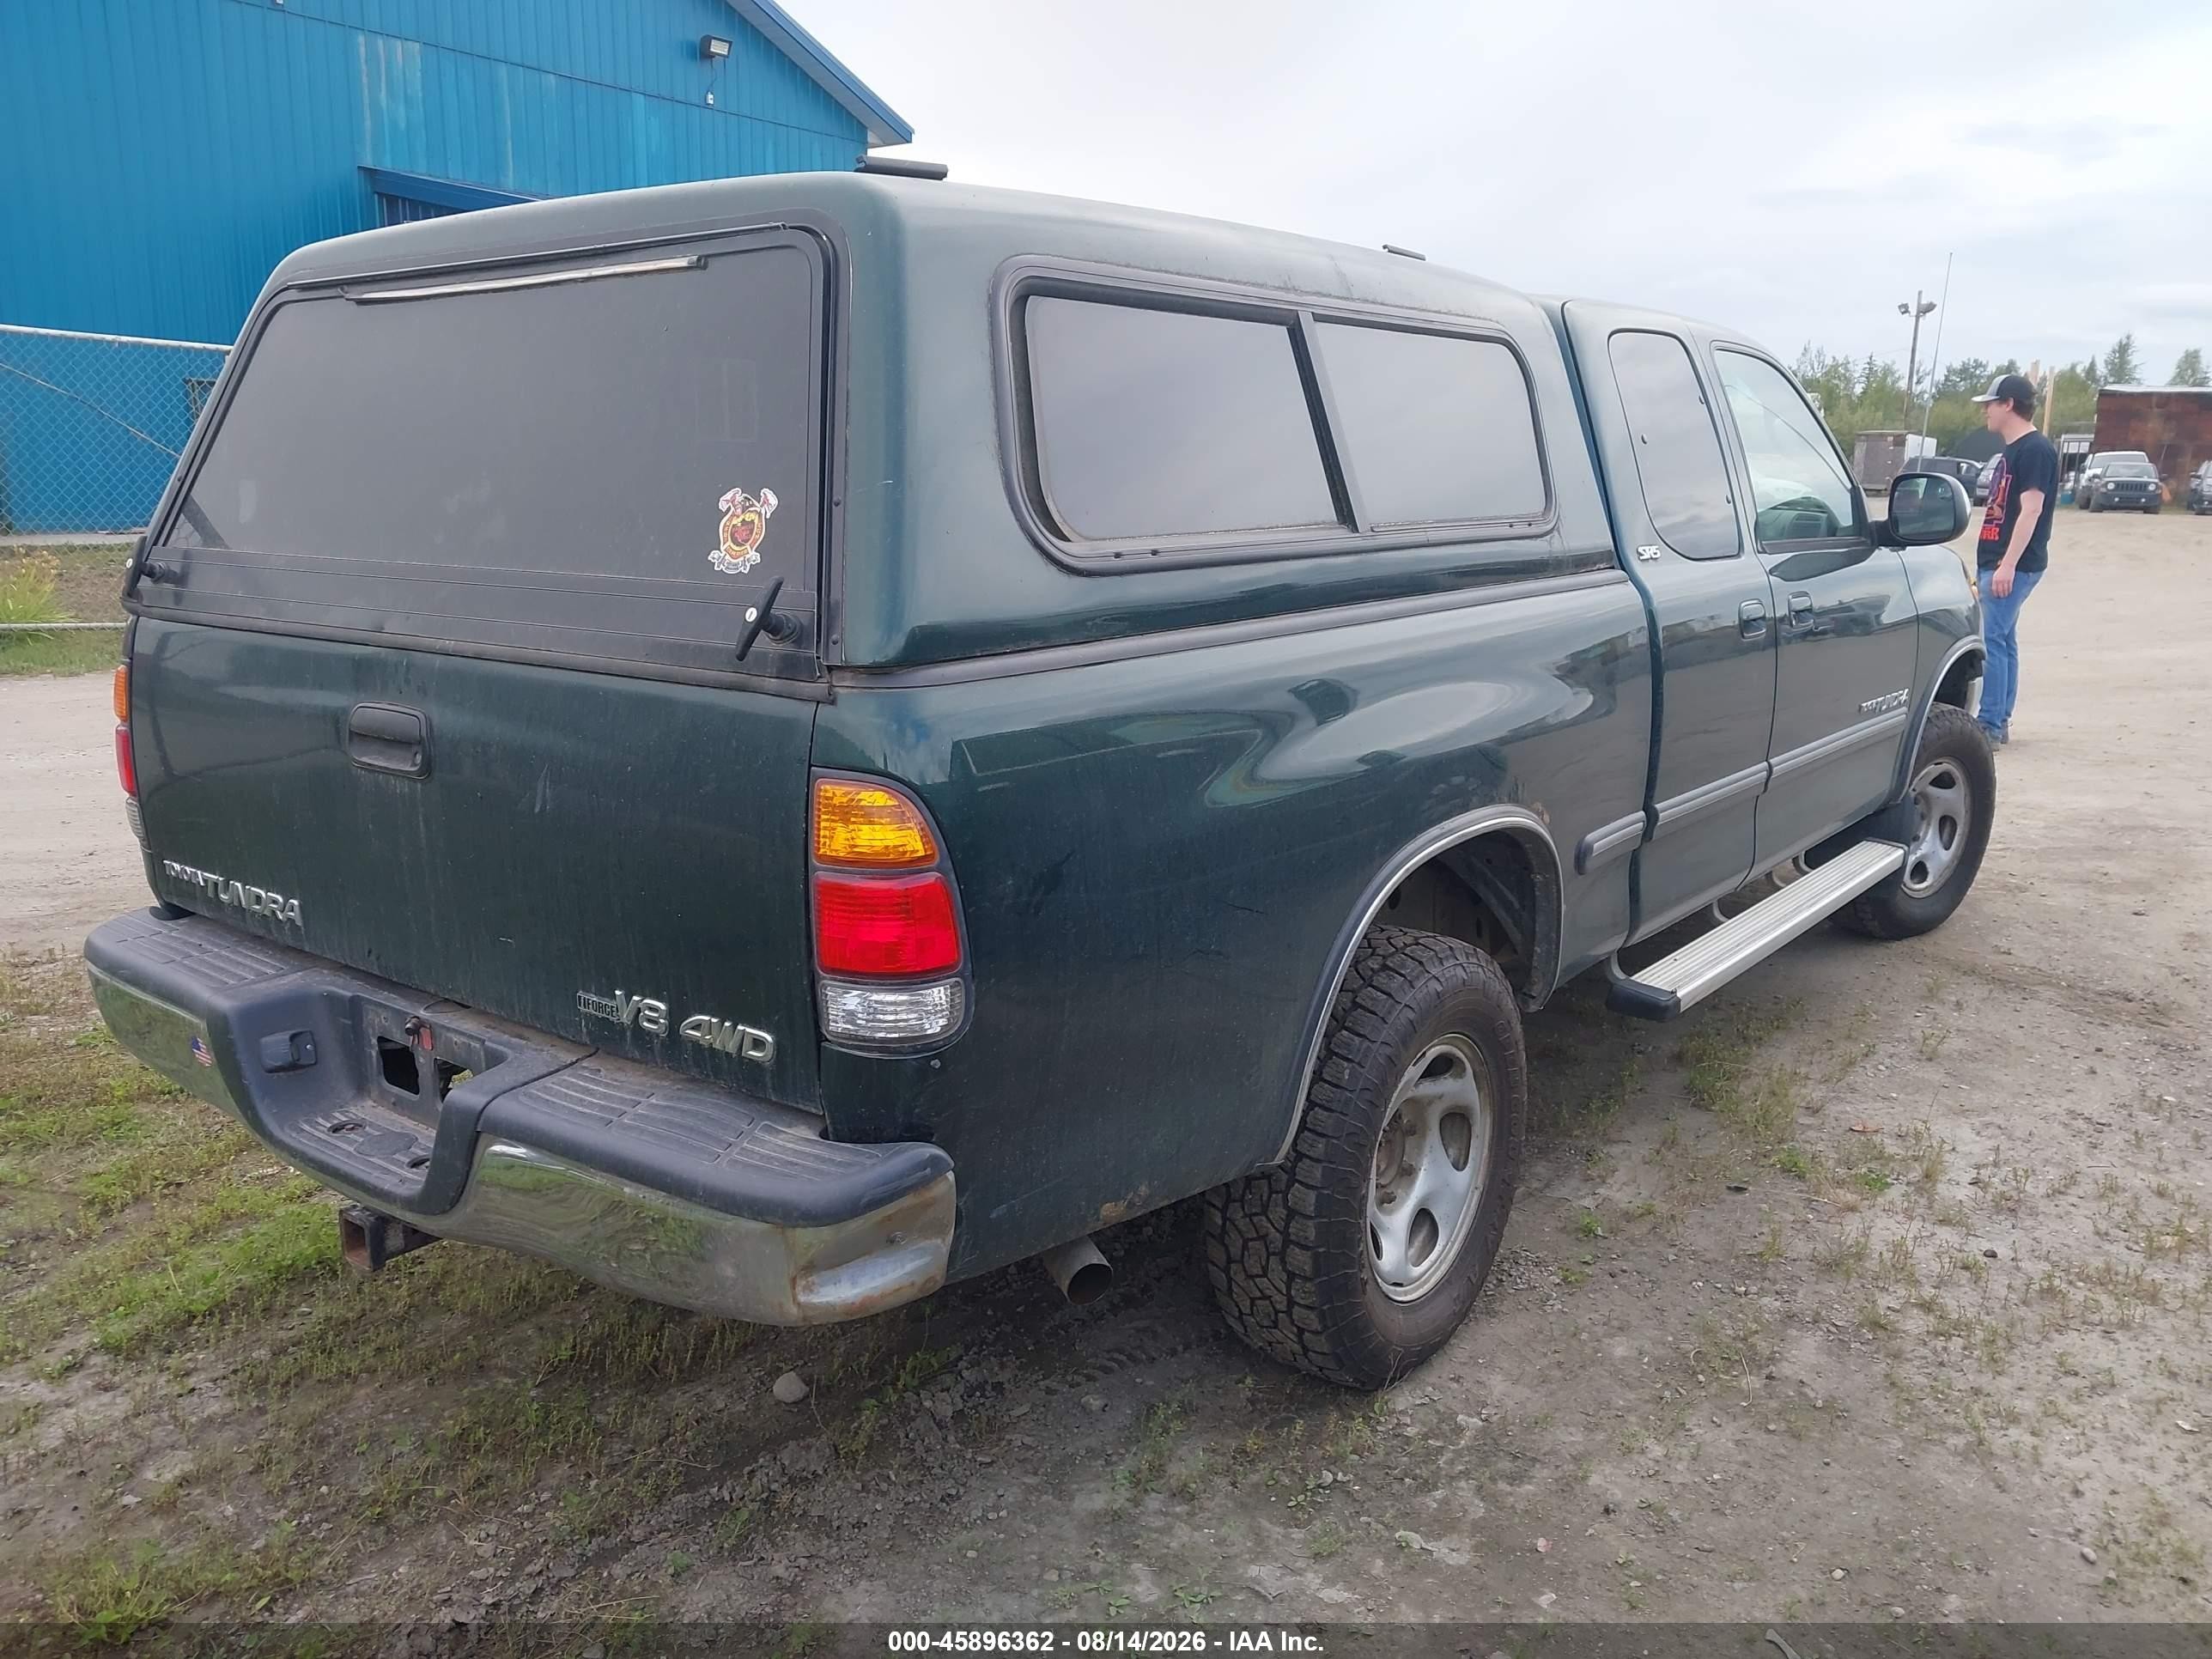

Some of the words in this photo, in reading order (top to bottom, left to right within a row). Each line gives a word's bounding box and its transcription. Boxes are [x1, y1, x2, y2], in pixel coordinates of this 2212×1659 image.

[162, 860, 205, 886] TOYOTA
[203, 872, 303, 927] TUNDRA
[615, 990, 670, 1036] V8
[679, 1015, 777, 1063] 4WD
